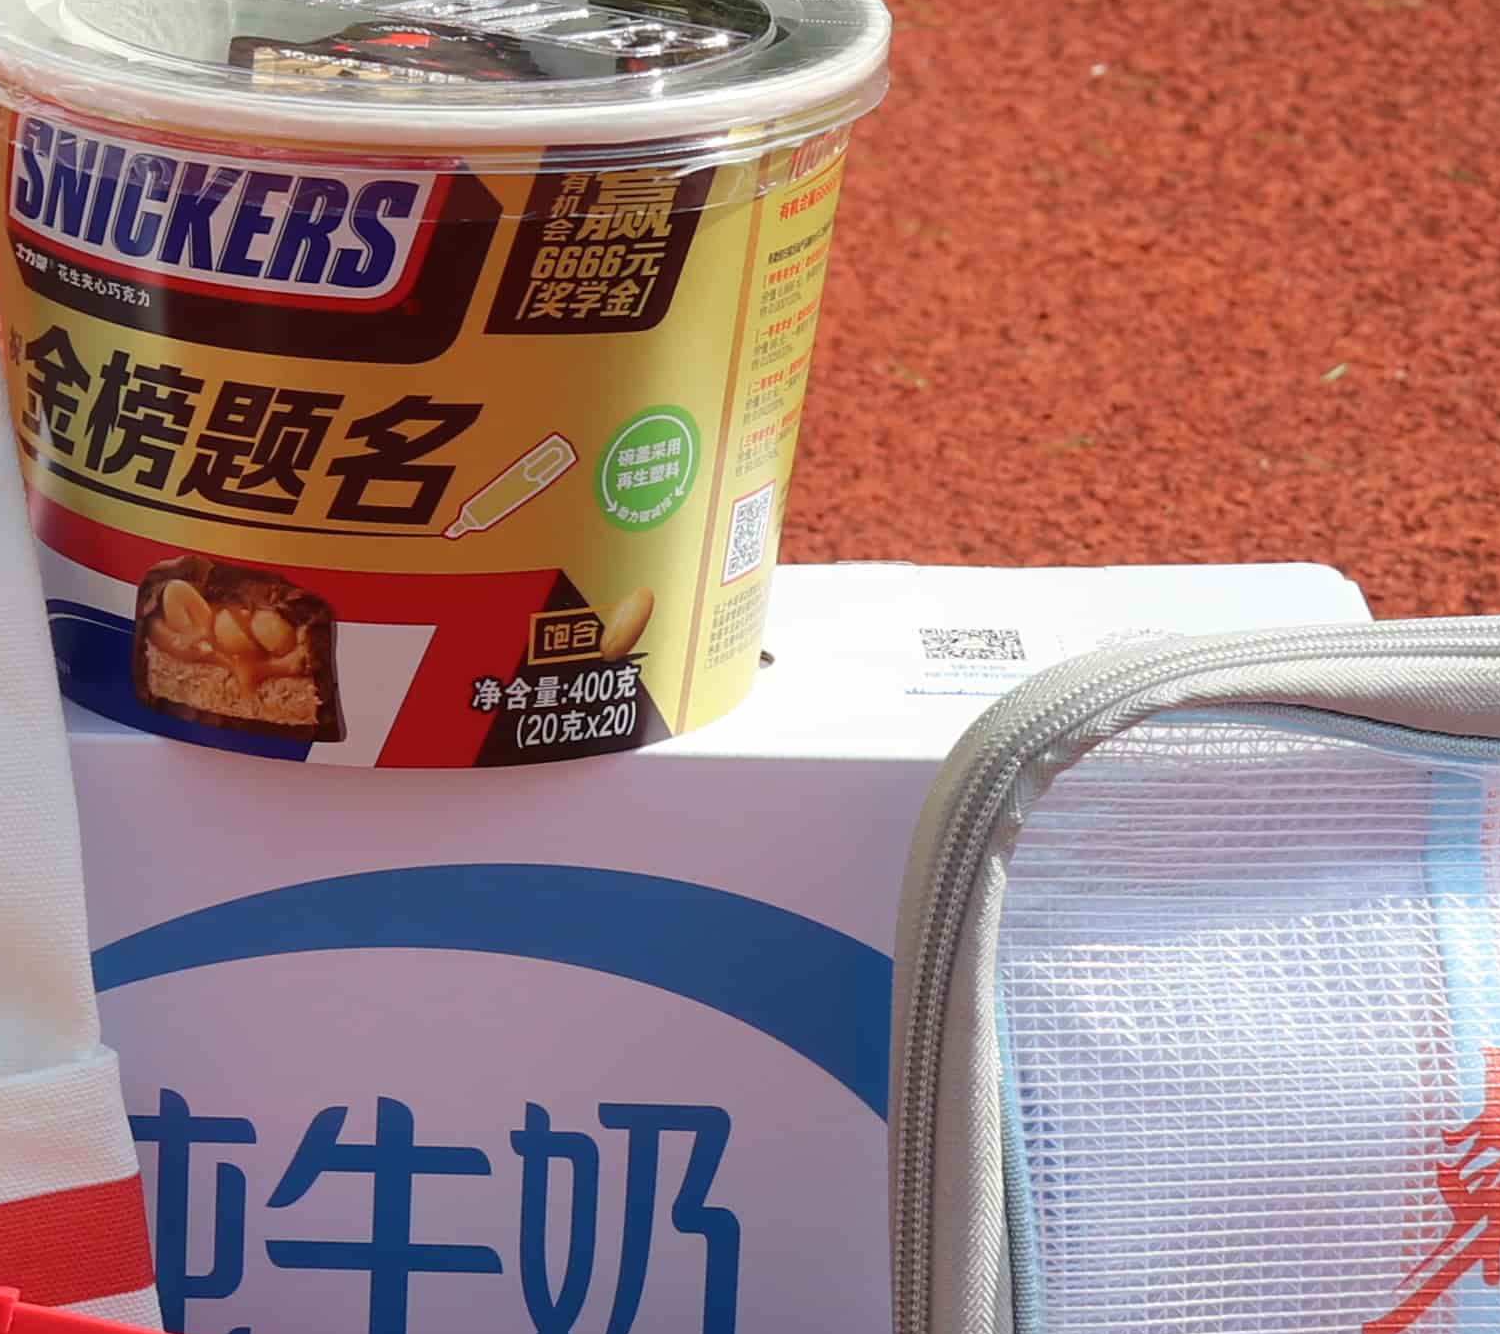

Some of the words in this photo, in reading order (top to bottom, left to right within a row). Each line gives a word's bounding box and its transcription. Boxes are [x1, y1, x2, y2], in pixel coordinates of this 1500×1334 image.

[12, 116, 418, 289] SNICKERS
[575, 167, 682, 241] 赢
[530, 241, 666, 279] 6666元
[58, 263, 151, 308] 花生夹心巧克力
[21, 323, 483, 525] 金榜题名
[543, 619, 600, 652] 饱含
[472, 665, 639, 712] 净含量:400克
